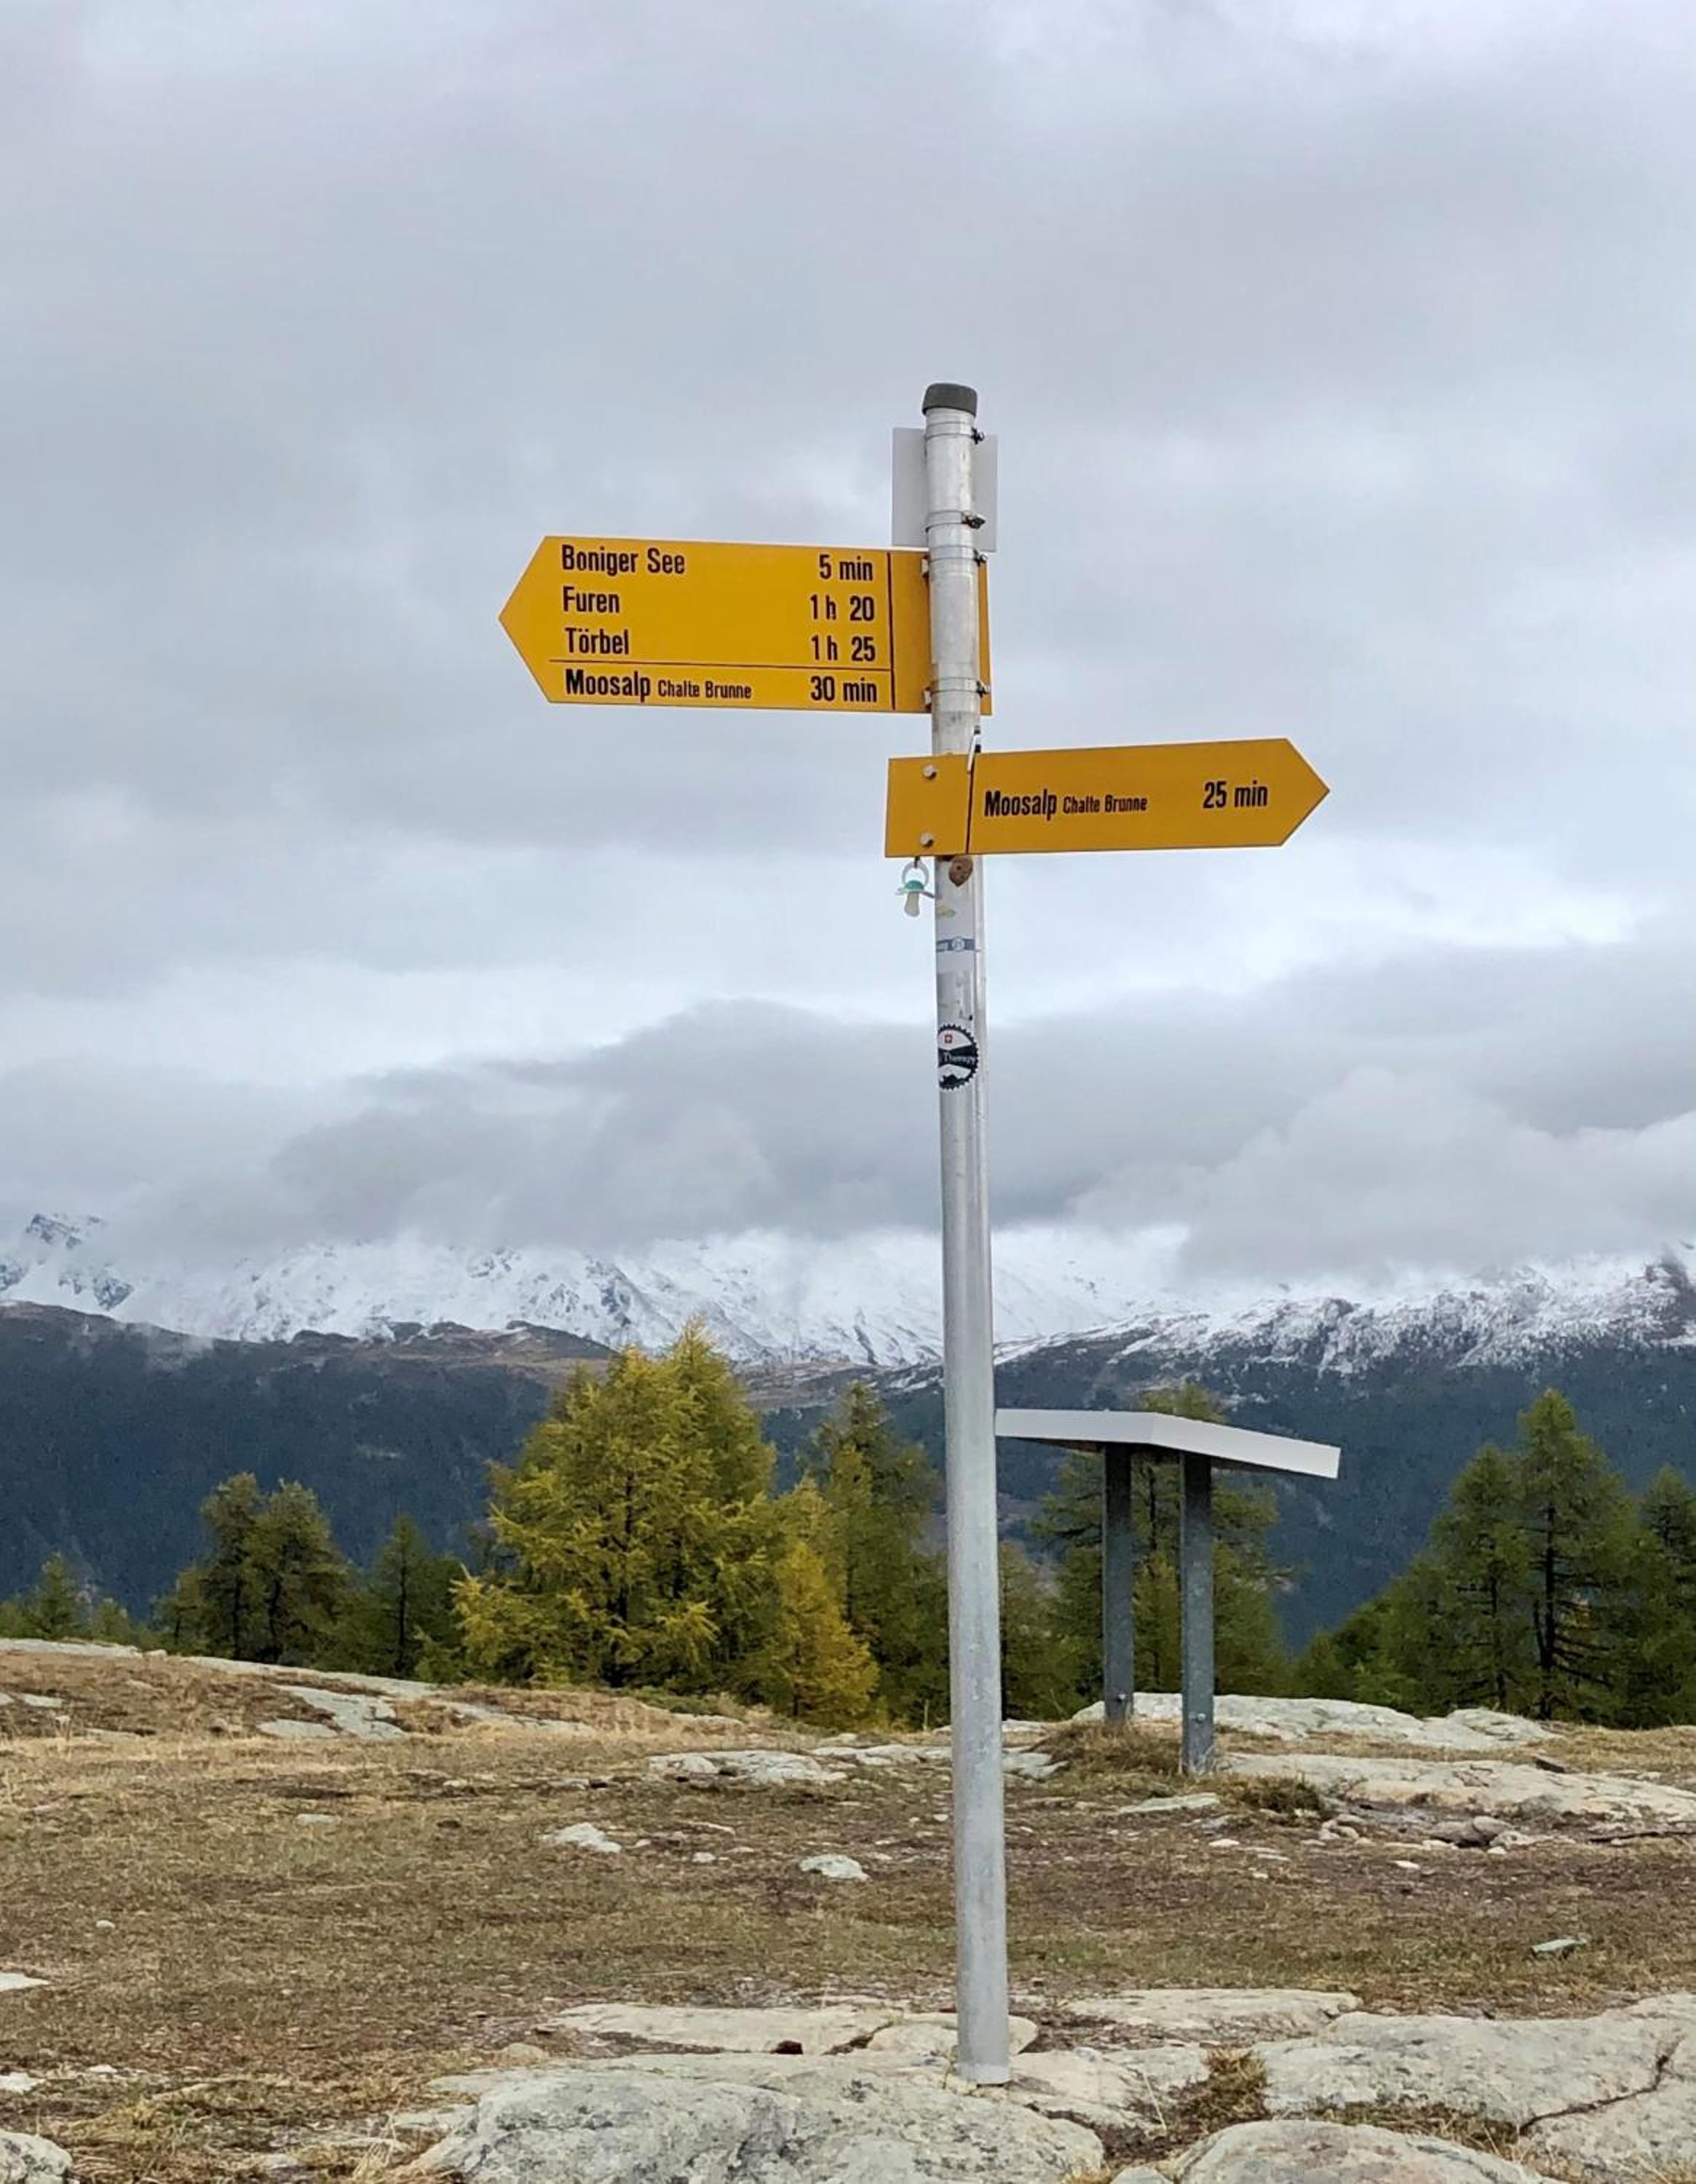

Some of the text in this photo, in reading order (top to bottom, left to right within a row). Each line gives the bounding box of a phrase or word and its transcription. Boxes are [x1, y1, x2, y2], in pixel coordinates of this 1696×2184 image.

[562, 544, 685, 577] Boniger See
[819, 554, 873, 581] 5 min
[563, 585, 620, 614] Furen
[810, 594, 875, 622] 1 h 20
[565, 627, 629, 654] Törbel
[811, 635, 876, 662] 1 h 25
[566, 668, 752, 703] Moosalp Chalte Brunne
[810, 675, 877, 703] 30 min
[983, 788, 1148, 821] Moosalp Chalte Brunne
[1202, 780, 1269, 809] 25 min
